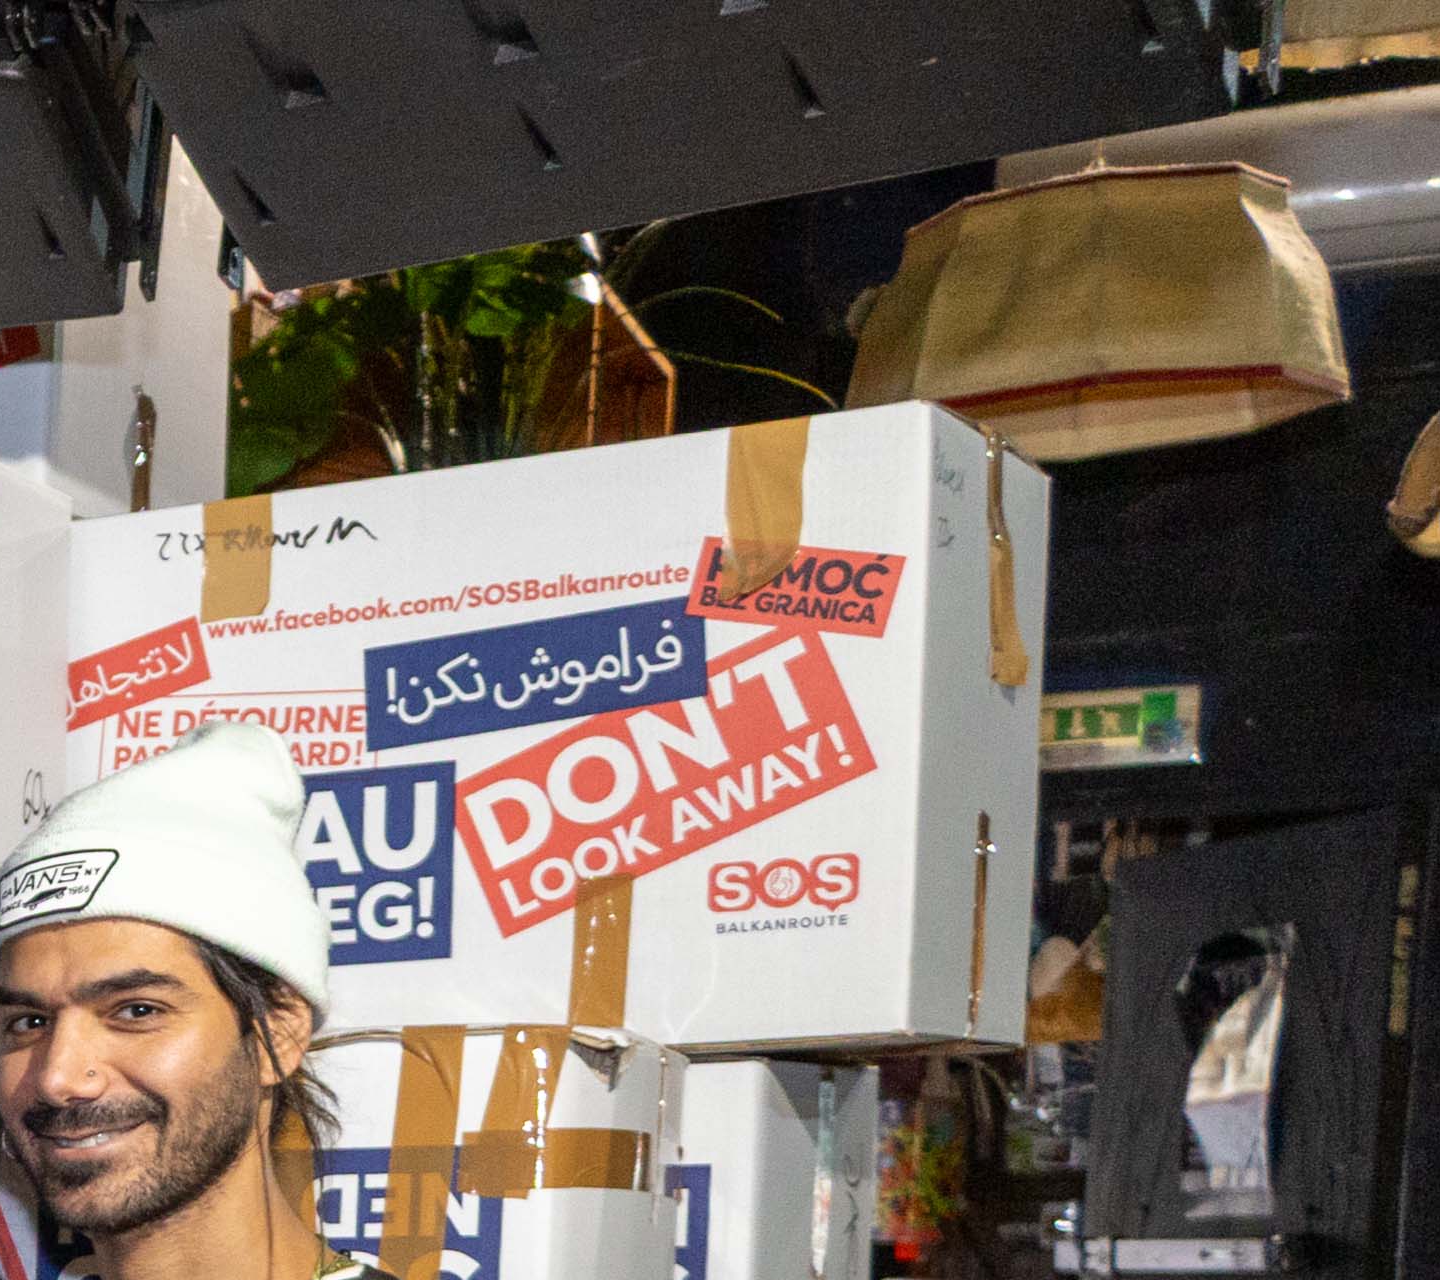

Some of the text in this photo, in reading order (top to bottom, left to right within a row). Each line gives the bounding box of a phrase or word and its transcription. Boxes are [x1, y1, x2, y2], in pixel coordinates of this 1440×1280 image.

[327, 516, 377, 544] M
[208, 563, 690, 639] www.facebook.com/SOSBalkanroute
[755, 592, 876, 625] GRANICA
[117, 711, 162, 739] NE
[498, 724, 851, 918] LOOK AWAY!
[14, 860, 100, 896] VANS NY
[708, 853, 860, 913] SOS
[716, 914, 849, 935] BALKANROUTE
